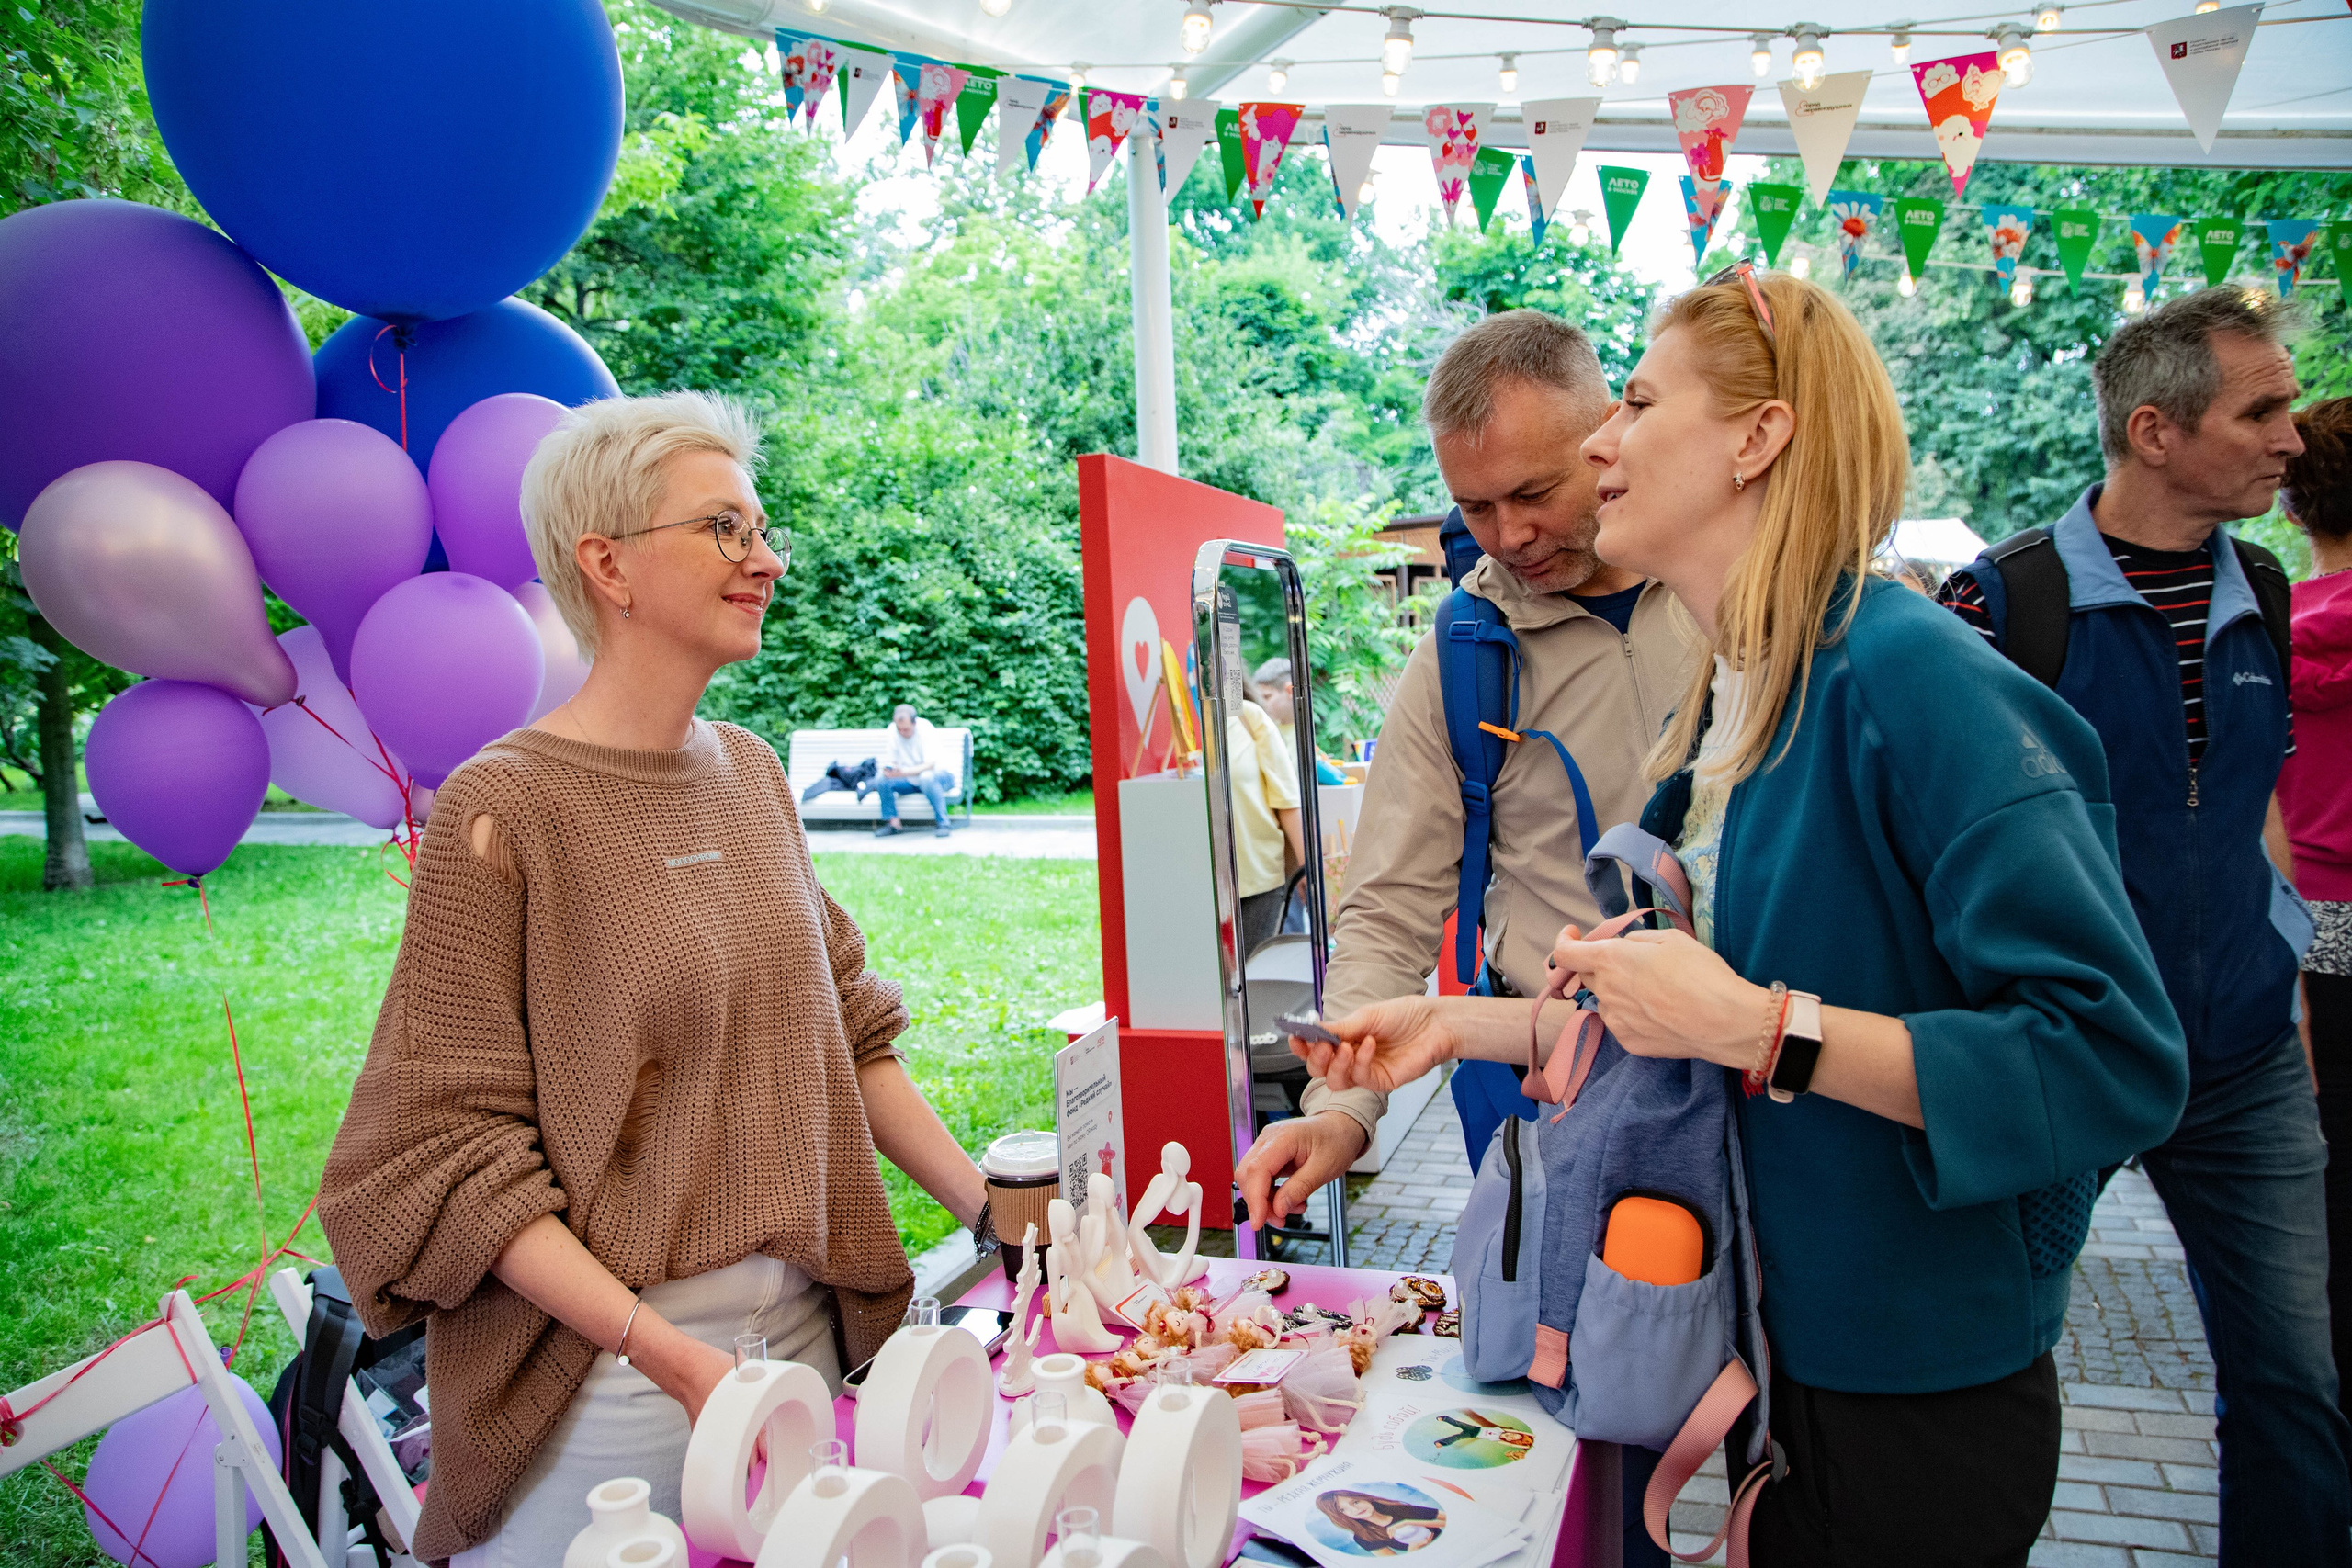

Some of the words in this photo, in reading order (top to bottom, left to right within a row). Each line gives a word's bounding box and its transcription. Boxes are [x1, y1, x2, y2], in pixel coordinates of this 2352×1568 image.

[1609, 177, 1639, 189] ЛЕТО
[1905, 209, 1935, 220] ЛЕТО
[2206, 230, 2235, 240] ЛЕТО
[667, 852, 721, 867] MONOCHROME
[1066, 1074, 1106, 1108] Благотворительный
[1066, 1089, 1073, 1098] Мы
[1066, 1105, 1079, 1119] фонд
[1383, 1404, 1421, 1429] собой!
